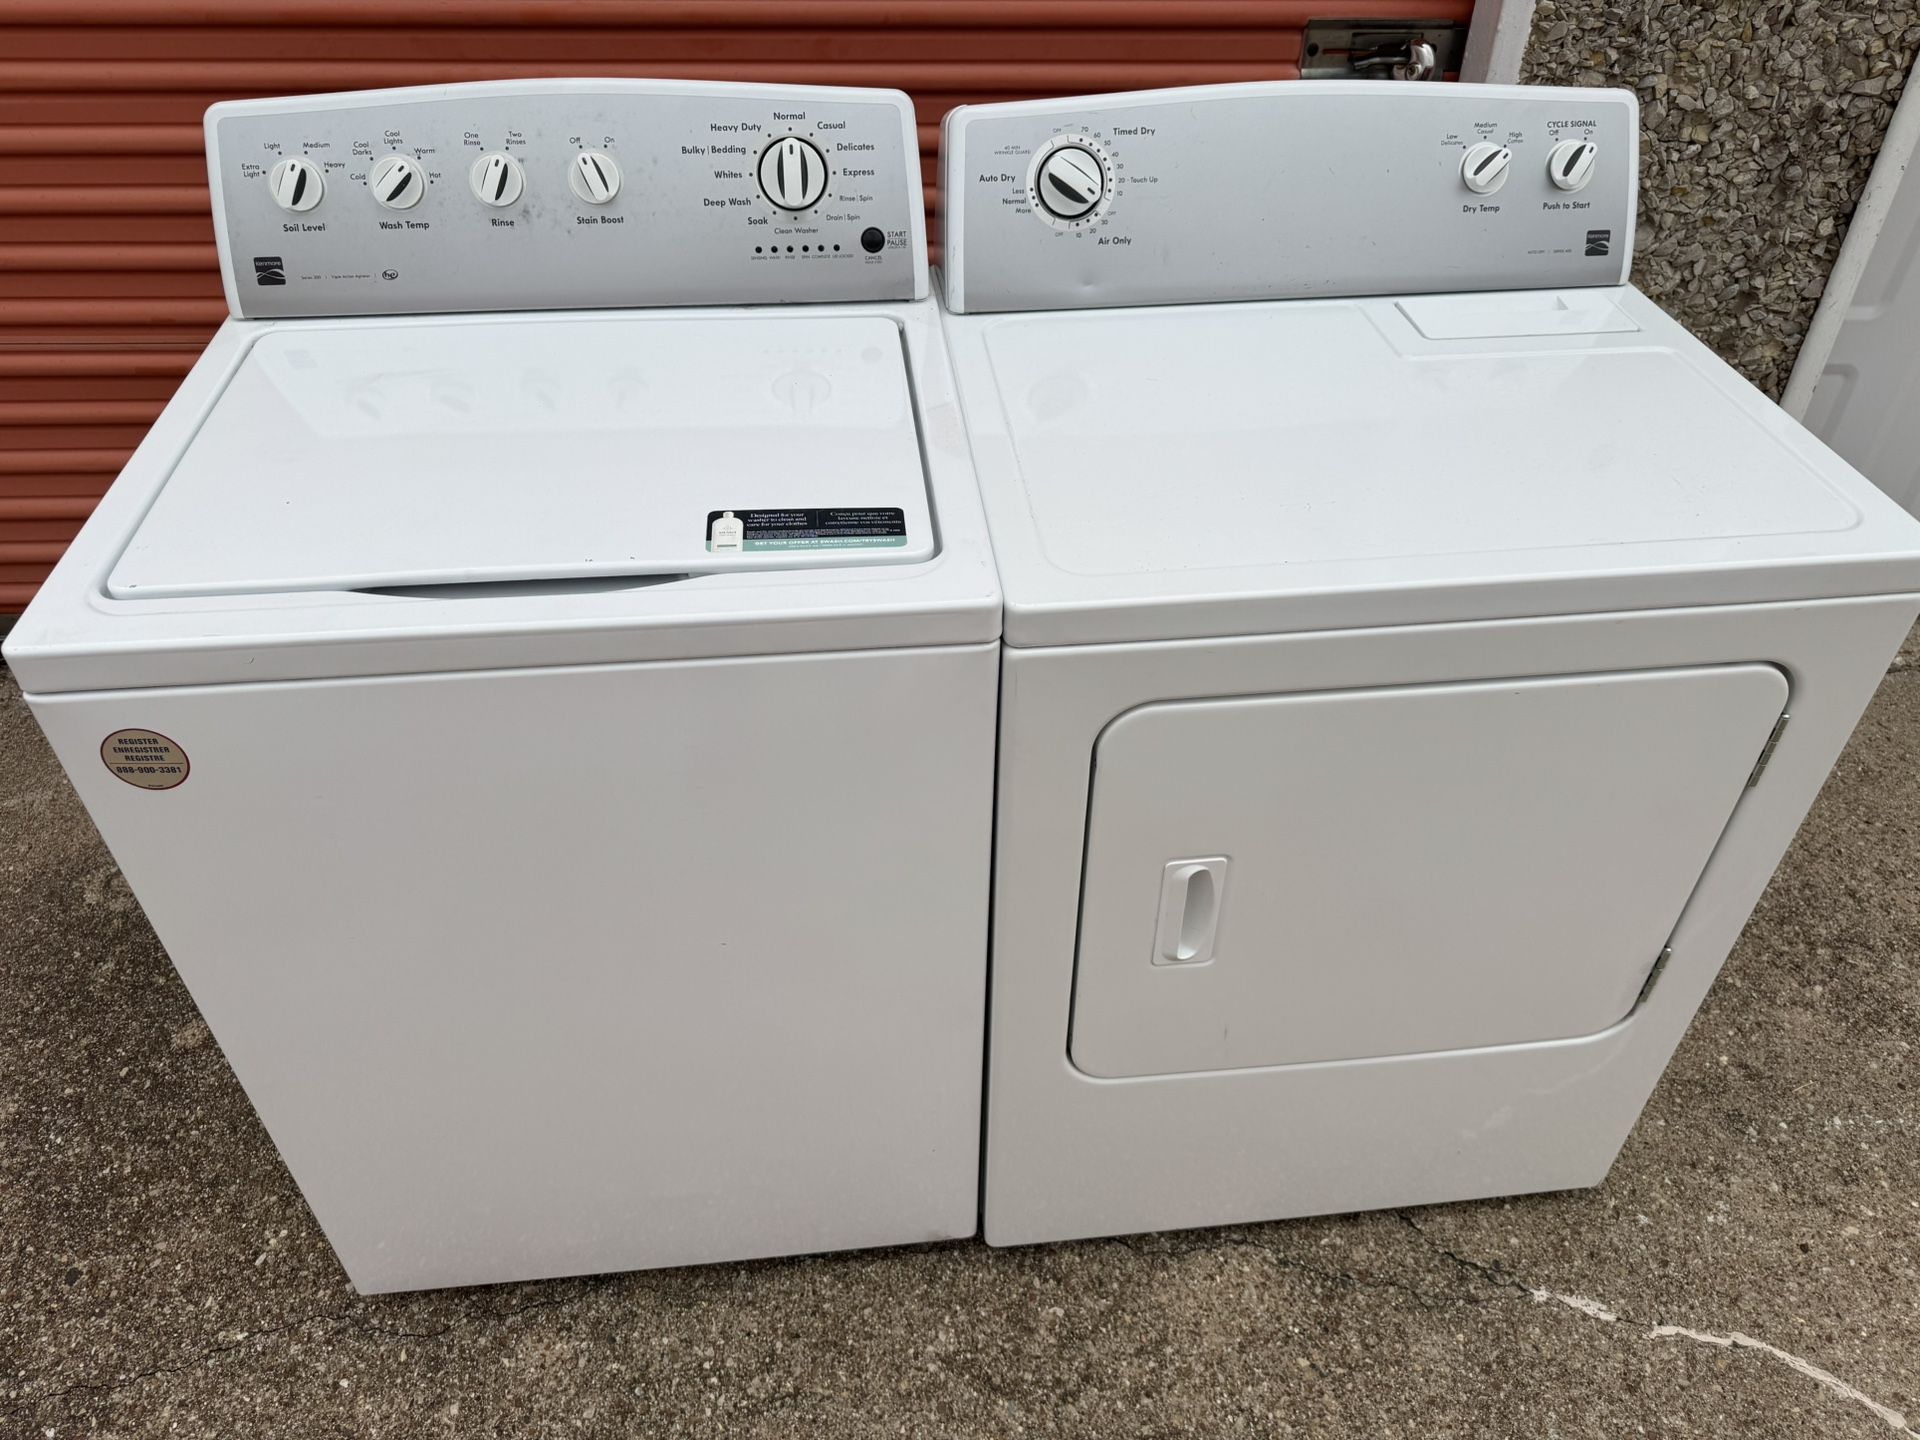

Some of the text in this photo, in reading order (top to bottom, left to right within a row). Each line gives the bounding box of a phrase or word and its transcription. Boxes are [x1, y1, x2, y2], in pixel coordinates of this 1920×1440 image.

[773, 112, 806, 121] Normal
[710, 122, 762, 133] Heavy Duty
[816, 121, 846, 130] Casual
[1112, 127, 1156, 137] Timed Dry
[383, 138, 404, 146] Lights
[681, 145, 746, 155] Bulky Bedding
[836, 143, 875, 152] Delicates
[324, 162, 346, 170] Heavy
[243, 170, 260, 178] Light
[714, 170, 743, 179] Whites
[842, 168, 875, 178] Express
[979, 174, 1016, 184] Auto Dry
[1148, 176, 1158, 184] Up
[859, 194, 874, 202] Spin
[703, 198, 752, 208] Deep Wash
[1542, 202, 1560, 210] Push
[1462, 204, 1500, 214] Dry Temp
[491, 218, 515, 227] Rinse
[576, 216, 624, 225] Stain Boost
[747, 216, 768, 225] Soak
[846, 214, 860, 223] Spin
[283, 223, 326, 232] Soil Level
[378, 220, 430, 230] Wash Temp
[1098, 236, 1132, 246] Air Only
